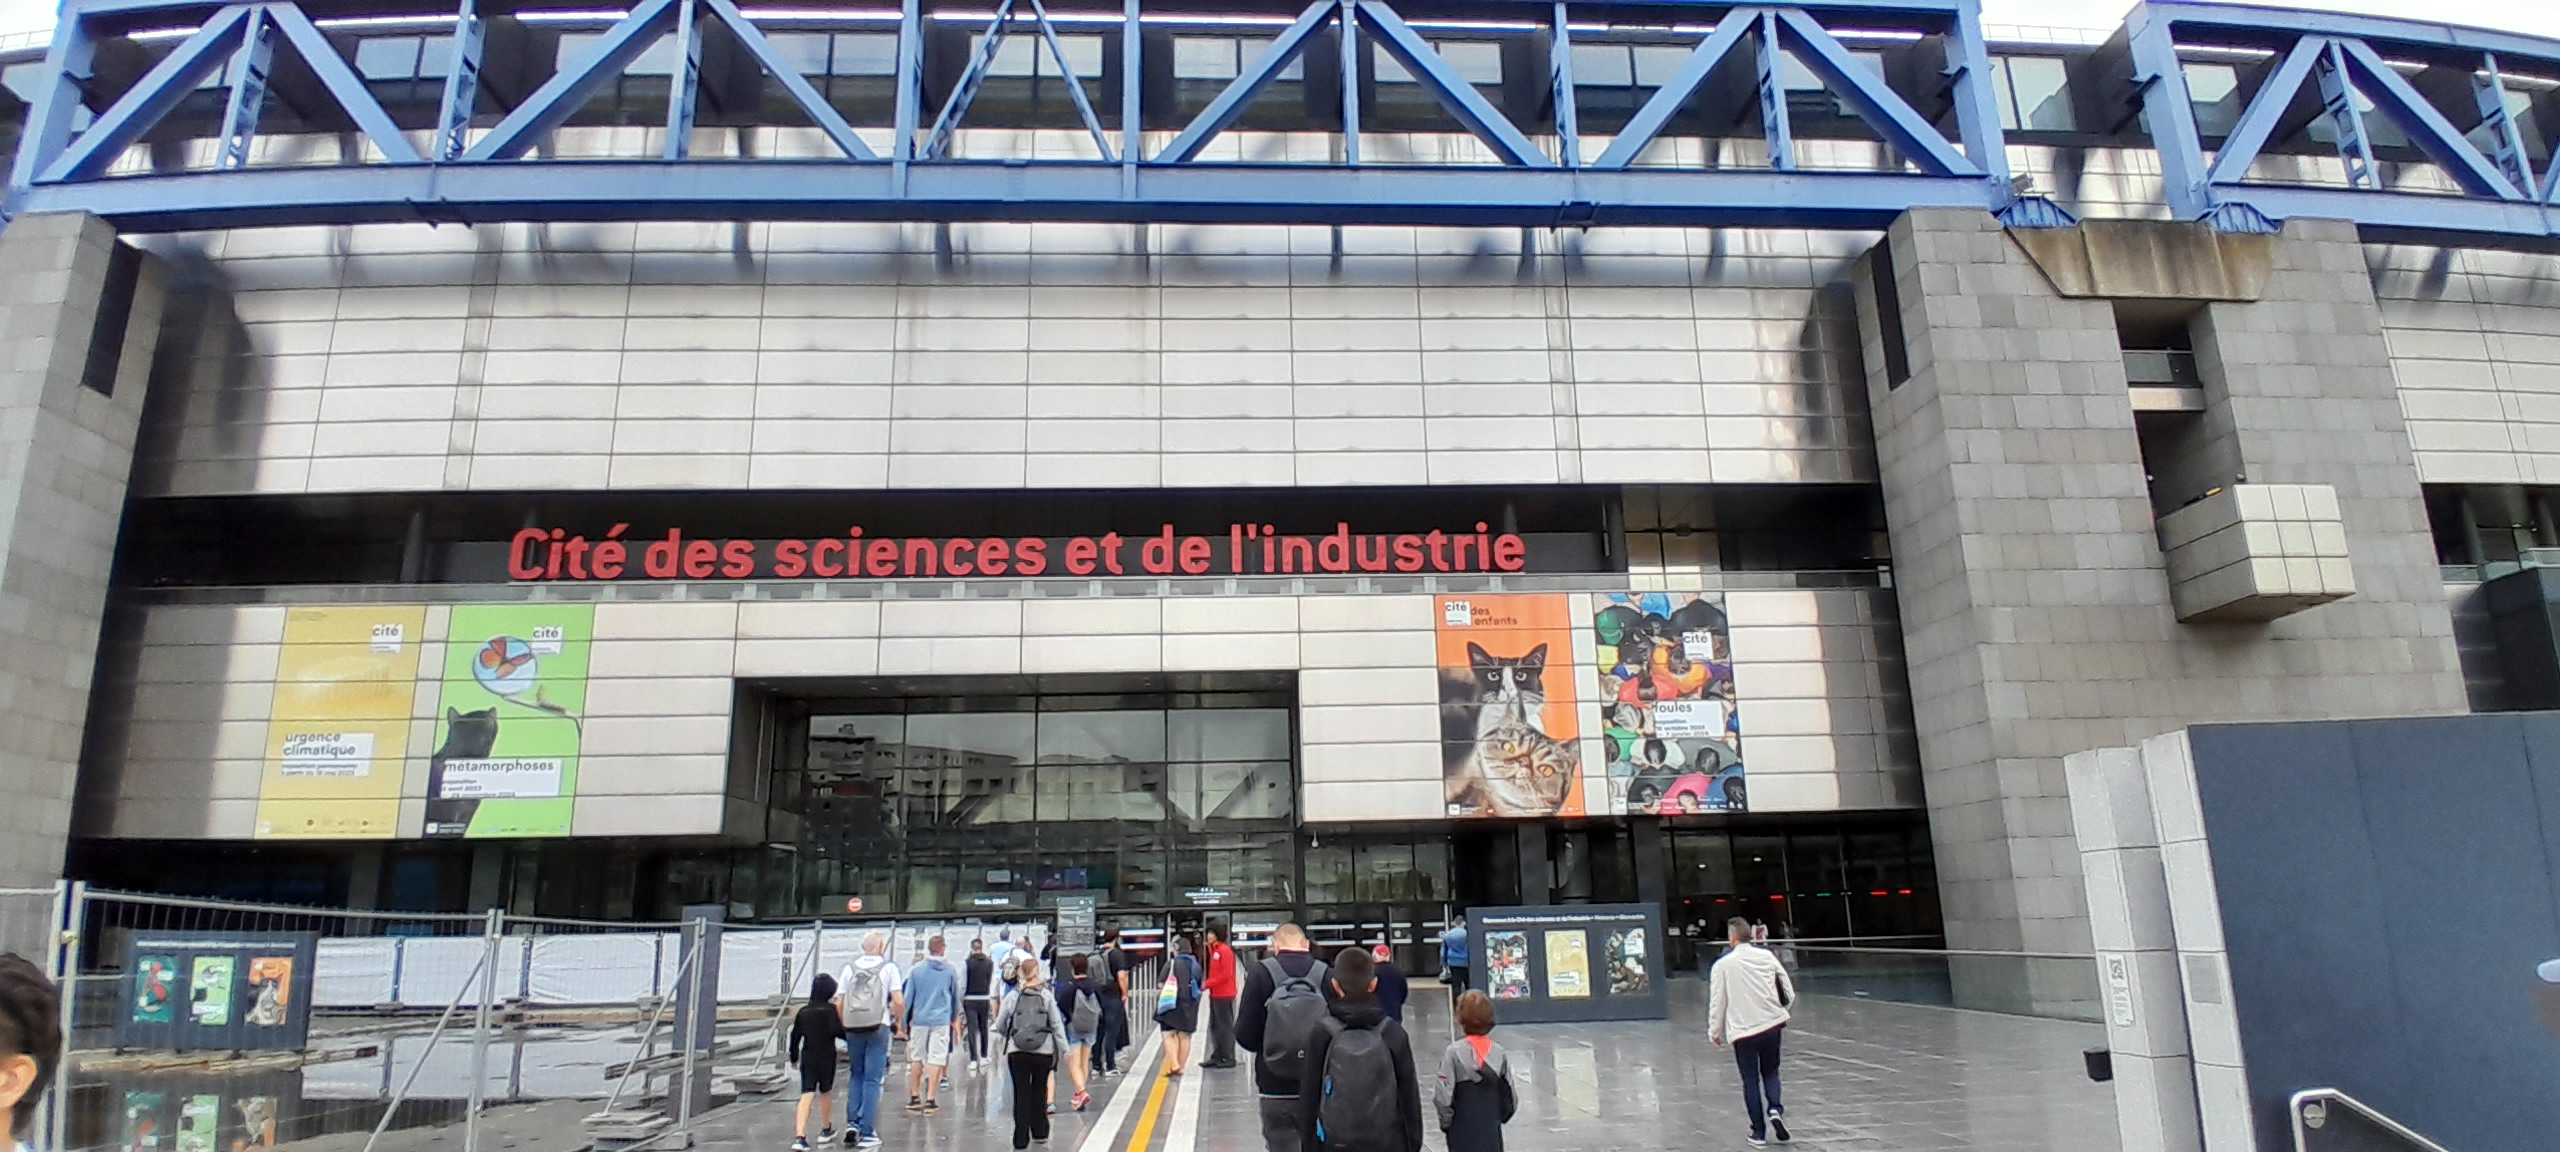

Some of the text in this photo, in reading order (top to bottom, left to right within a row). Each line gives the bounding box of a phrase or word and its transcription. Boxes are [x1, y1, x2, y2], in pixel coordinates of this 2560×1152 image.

[508, 521, 1526, 581] Cité des sciences et de l'industrie
[1471, 606, 1490, 616] des
[1475, 616, 1518, 626] enfants
[372, 624, 399, 637] cité
[532, 626, 559, 638] cité
[1652, 701, 1692, 713] foules
[285, 731, 341, 745] urgence
[283, 744, 356, 758] climatique
[445, 758, 554, 774] métamorphoses
